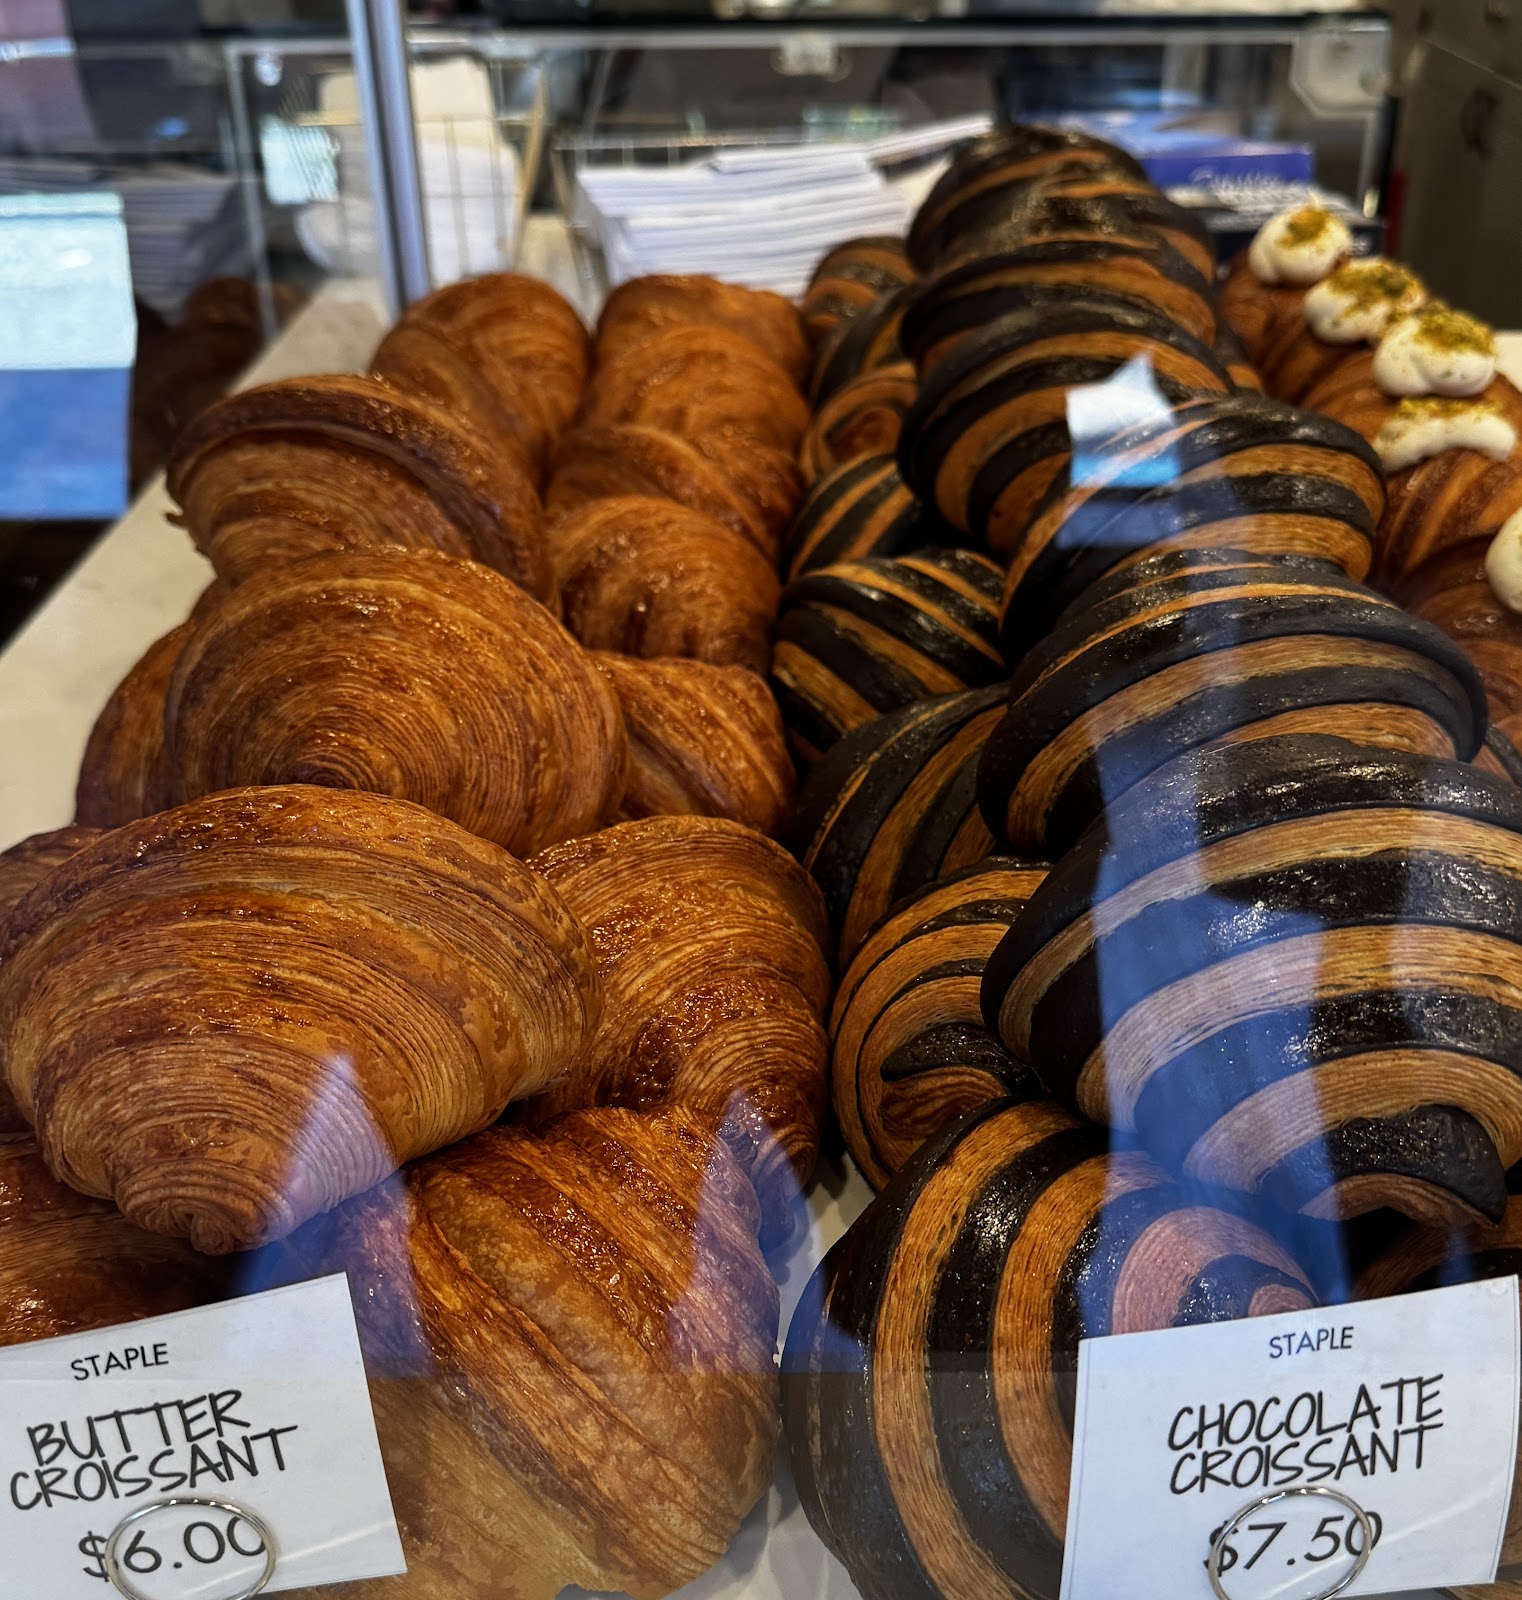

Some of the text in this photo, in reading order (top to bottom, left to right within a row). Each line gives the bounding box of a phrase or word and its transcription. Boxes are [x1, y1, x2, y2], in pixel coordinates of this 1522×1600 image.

[71, 1343, 169, 1380] STAPLE
[1269, 1326, 1354, 1359] STAPLE
[27, 1390, 250, 1465] BUTTER
[1168, 1374, 1444, 1451] CHOCOLATE
[11, 1425, 298, 1510] CROISSANT
[1170, 1422, 1444, 1494] CROISSANT
[1203, 1511, 1383, 1577] $7.50
